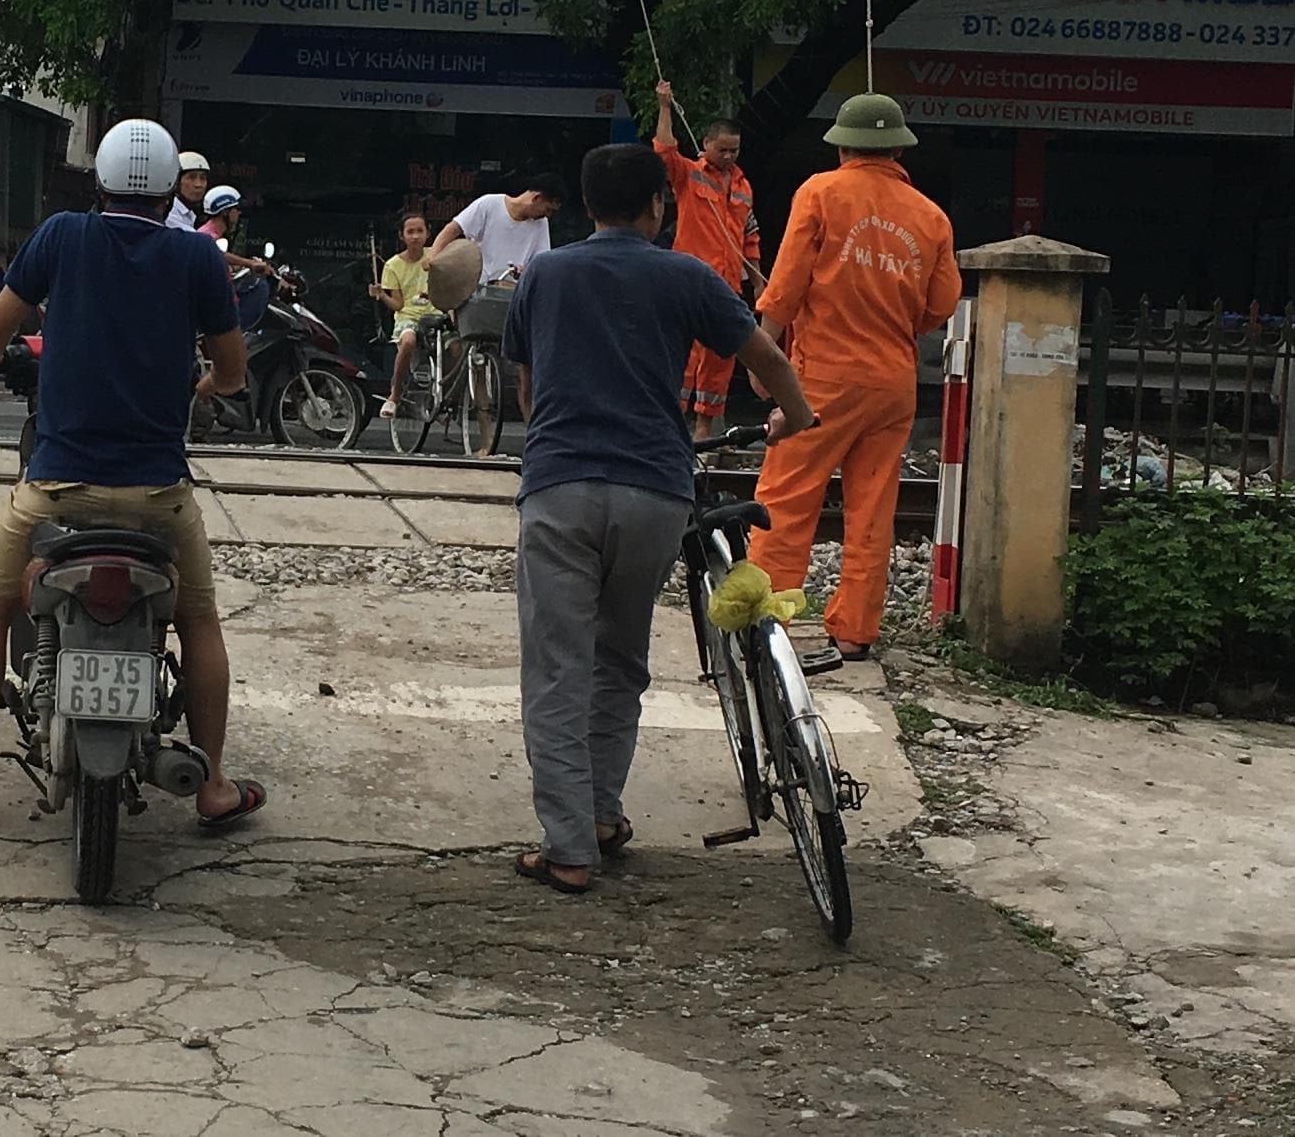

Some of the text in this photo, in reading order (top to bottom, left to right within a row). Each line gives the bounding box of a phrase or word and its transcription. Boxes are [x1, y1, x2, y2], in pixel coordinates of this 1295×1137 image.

[962, 14, 1003, 37] ĐT:
[297, 46, 487, 73] ĐẠI LÝ KHÁNH LINH
[959, 64, 1139, 94] vietnamobile
[339, 88, 424, 106] vinaphone
[1036, 105, 1196, 126] VIETNAMOBILE
[855, 245, 910, 277] HÀ TÂY
[72, 655, 141, 685] 30-X5
[70, 685, 140, 716] 6357
